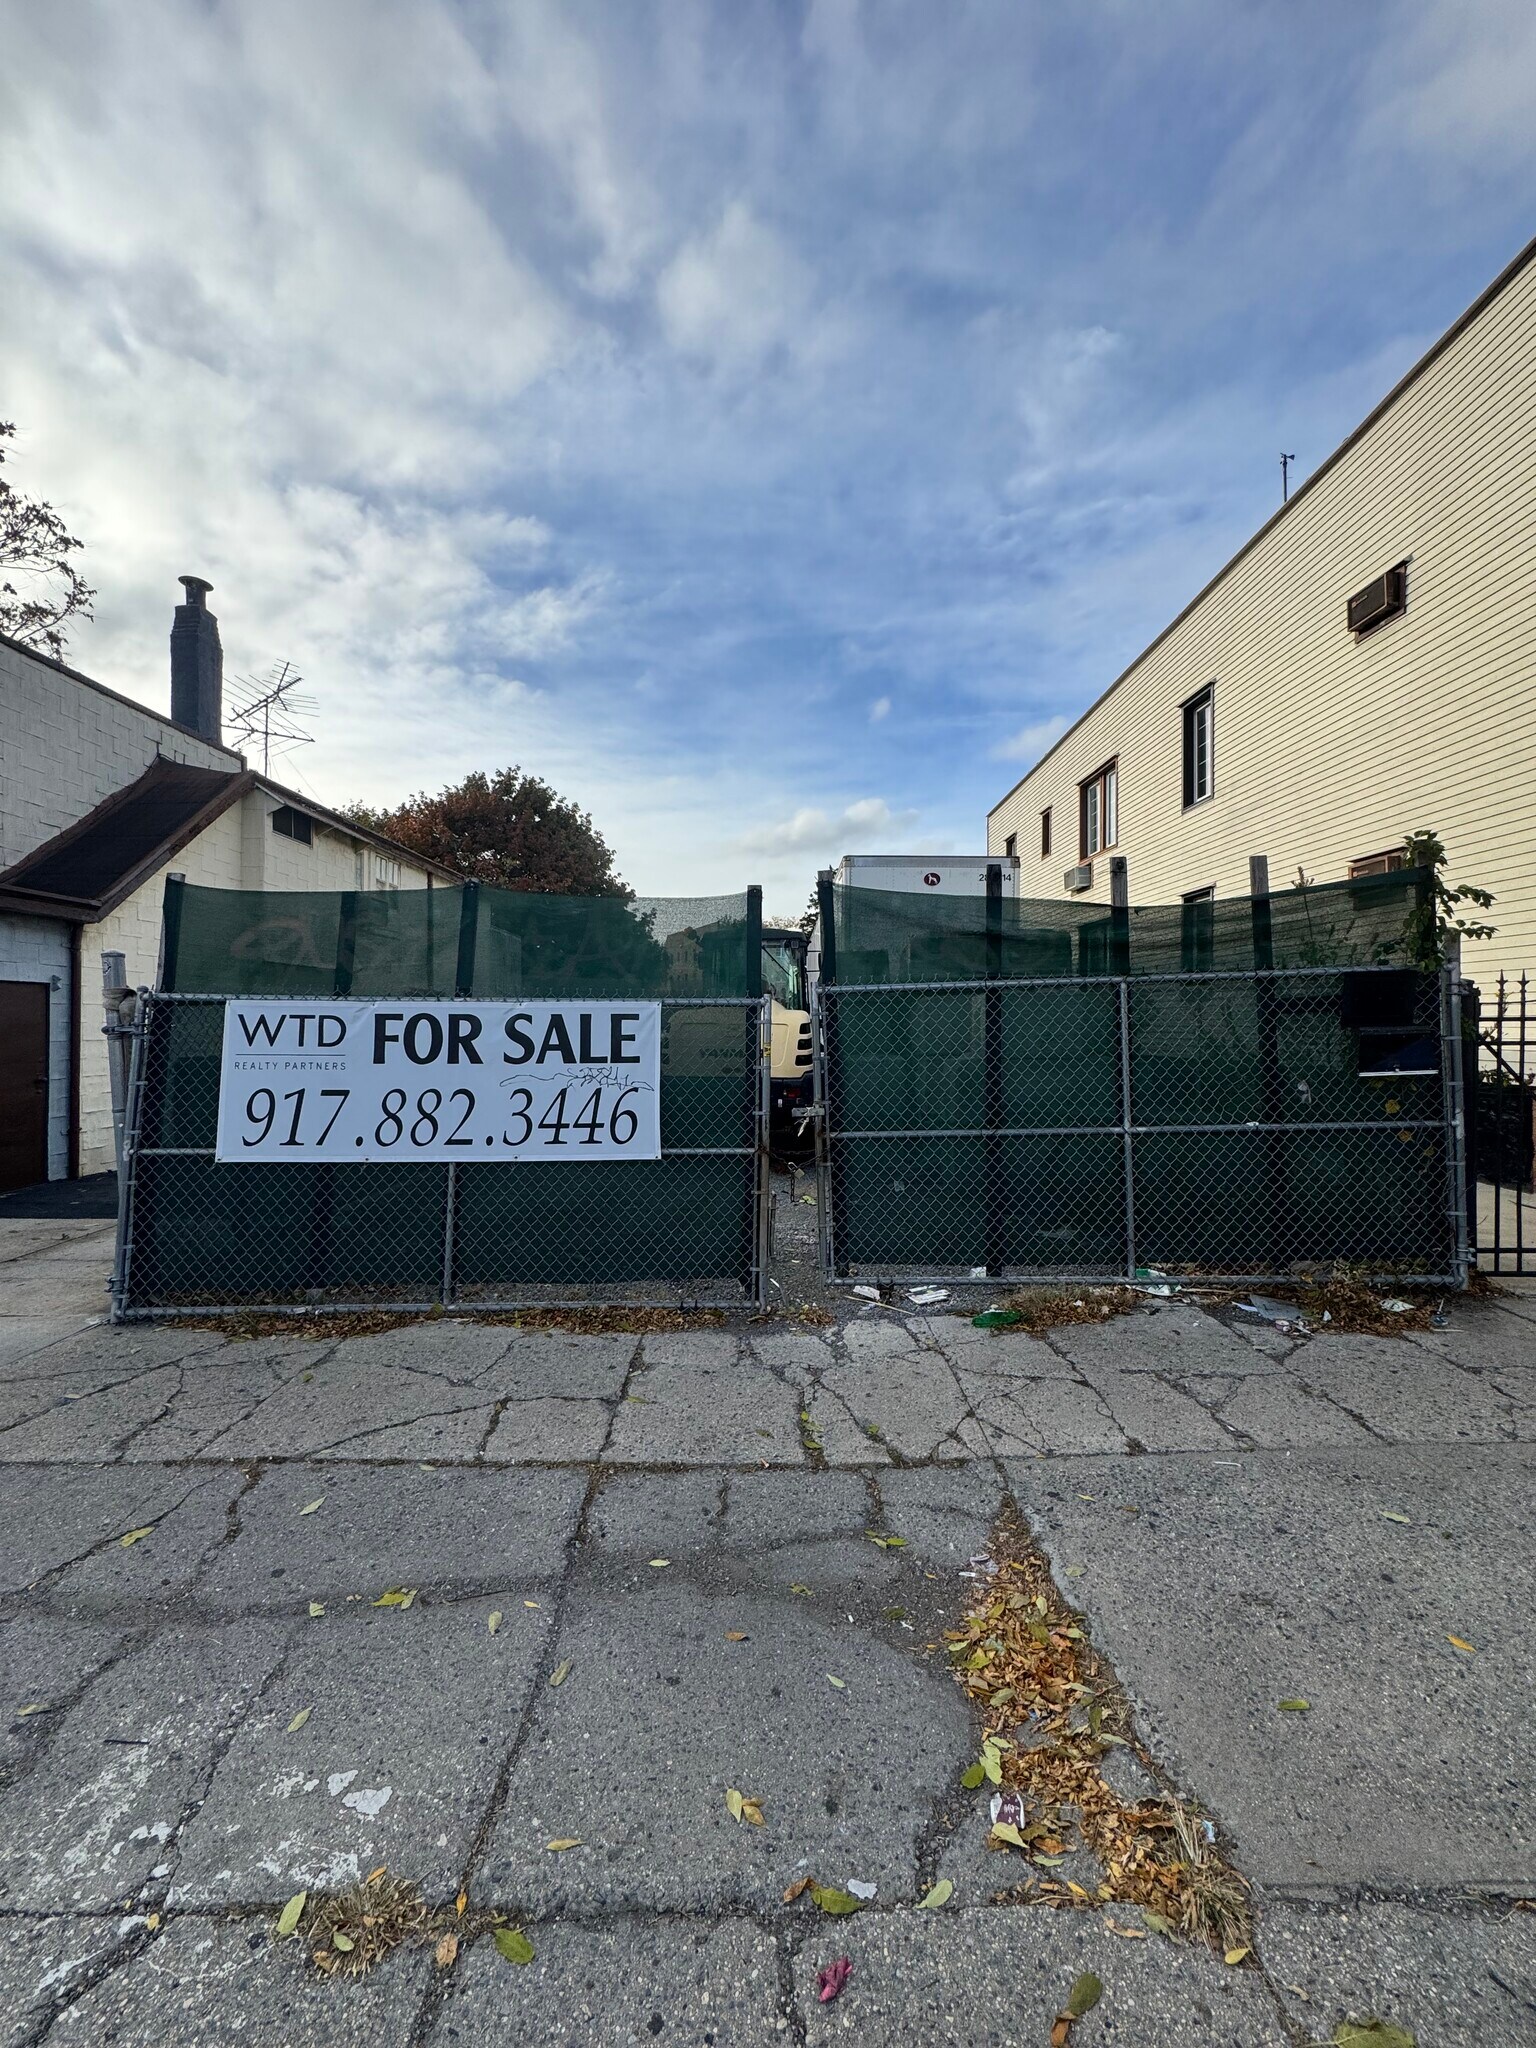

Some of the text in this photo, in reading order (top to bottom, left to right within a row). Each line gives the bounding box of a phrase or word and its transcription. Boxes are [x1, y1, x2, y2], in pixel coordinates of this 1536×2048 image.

[237, 1013, 347, 1048] WTD
[372, 1012, 641, 1065] FOR SALE
[234, 1061, 347, 1071] REALTY PARTNERS
[241, 1087, 639, 1147] 917.882.3446
